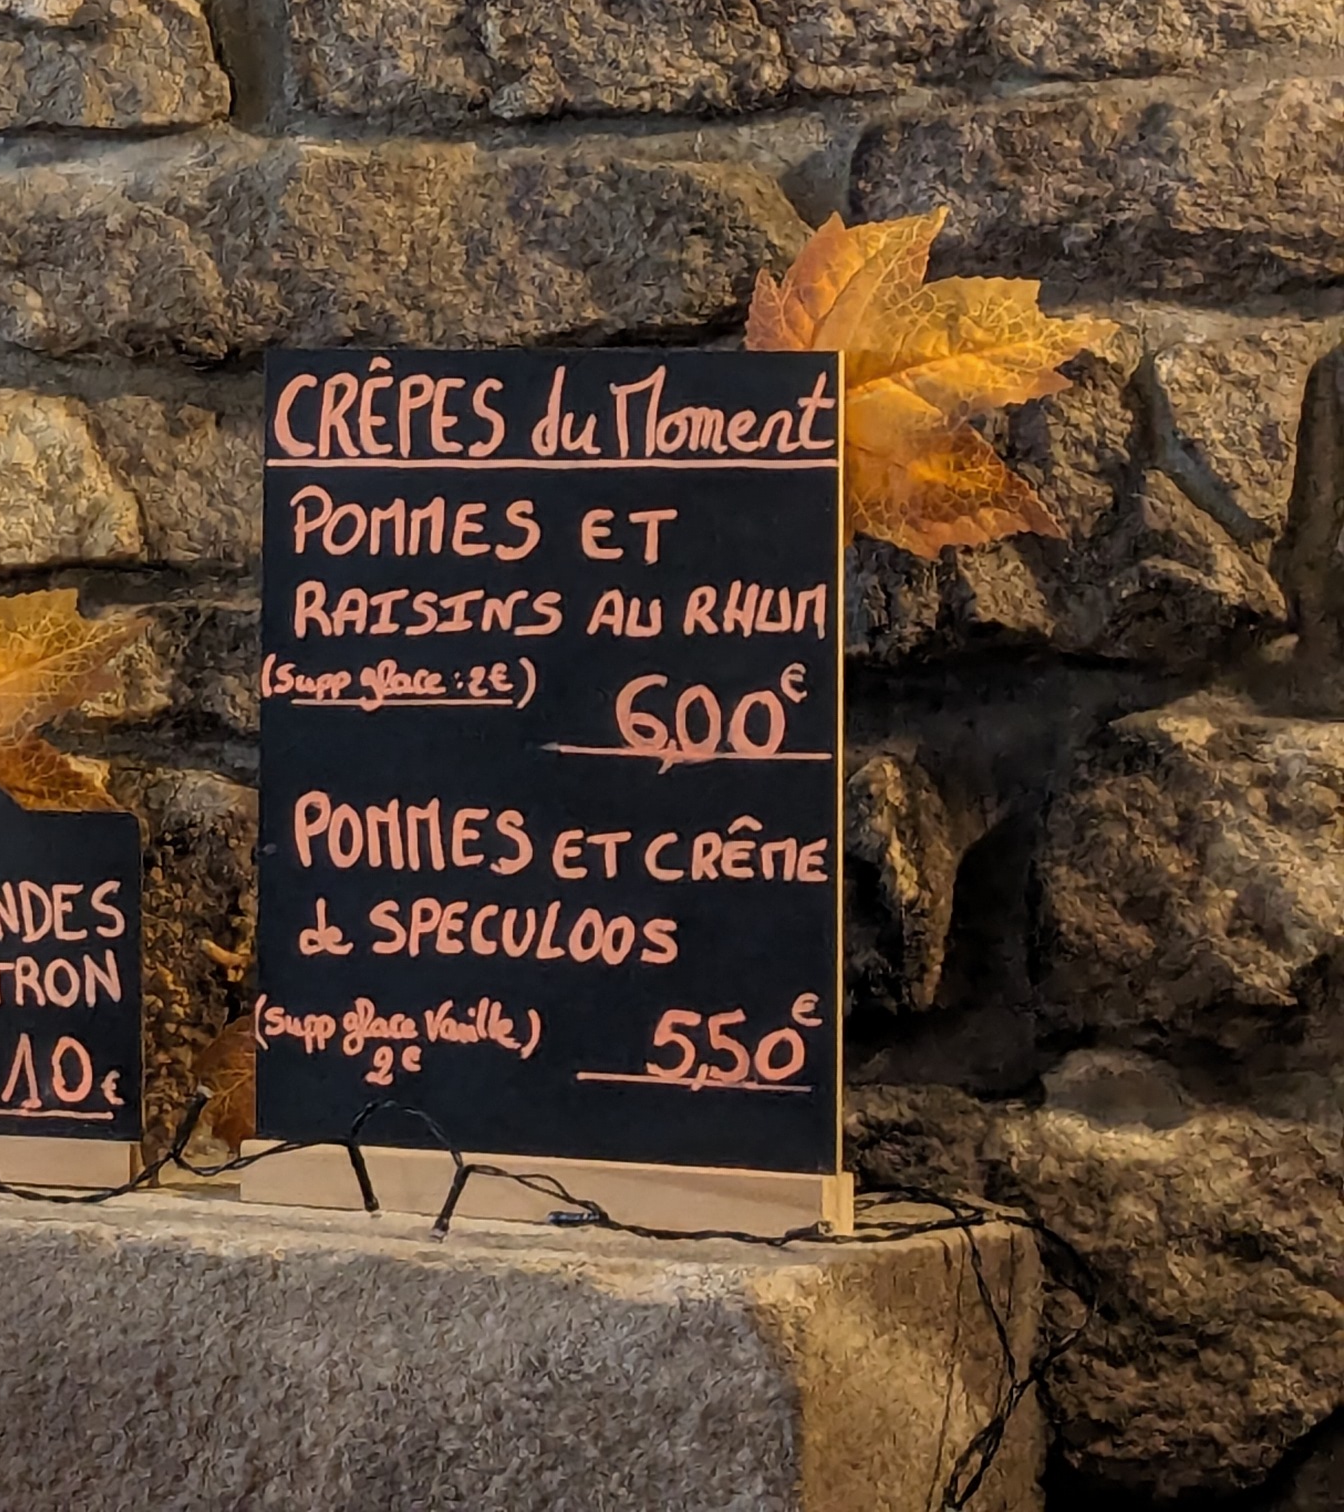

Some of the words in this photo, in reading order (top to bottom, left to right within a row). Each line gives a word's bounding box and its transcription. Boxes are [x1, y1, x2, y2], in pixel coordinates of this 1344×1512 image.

[273, 356, 507, 458] CRÊPES
[532, 364, 603, 456] du
[289, 484, 543, 561] POMMES
[579, 508, 679, 565] ET
[293, 579, 563, 640] RAISINS
[586, 588, 663, 638] AU
[682, 578, 828, 640] RHUM
[293, 789, 534, 876] POMMES
[551, 828, 633, 880] ET
[643, 814, 830, 883] CRÊME
[298, 897, 355, 956] de
[368, 897, 680, 966] SPECULOOS
